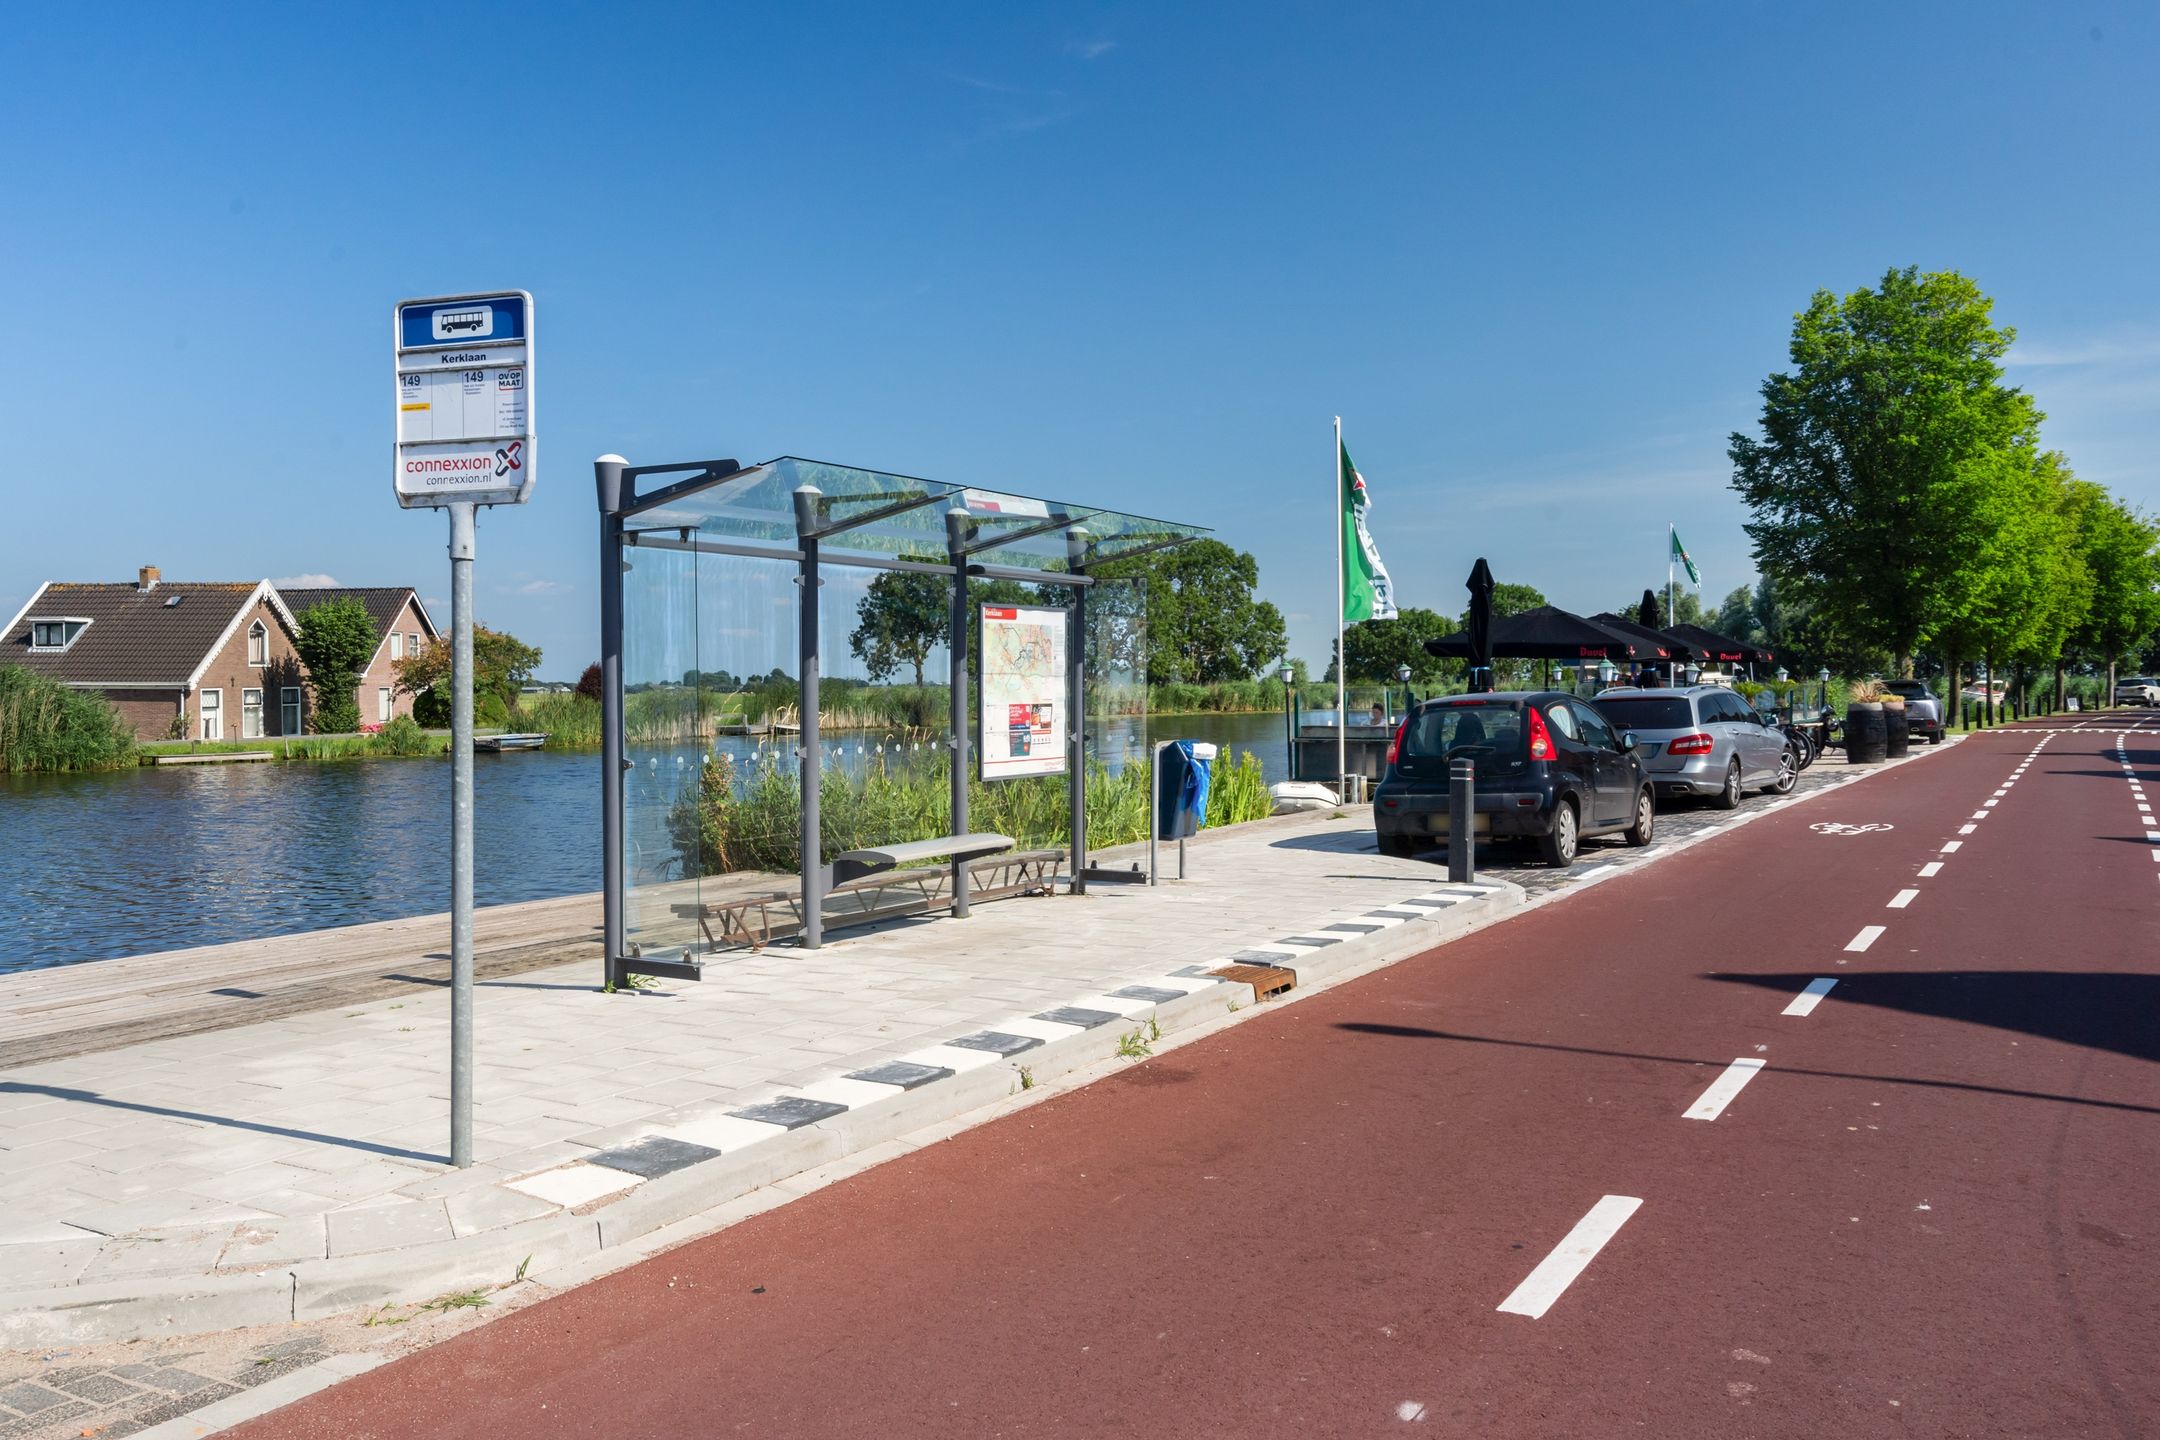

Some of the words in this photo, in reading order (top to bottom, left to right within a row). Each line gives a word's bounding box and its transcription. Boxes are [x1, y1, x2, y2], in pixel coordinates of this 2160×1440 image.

[441, 353, 487, 364] Kerklaan
[401, 375, 421, 387] 149
[464, 371, 484, 383] 149
[498, 379, 521, 387] MAAT
[406, 457, 492, 473] connexxion
[426, 472, 492, 486] connexxion.nl
